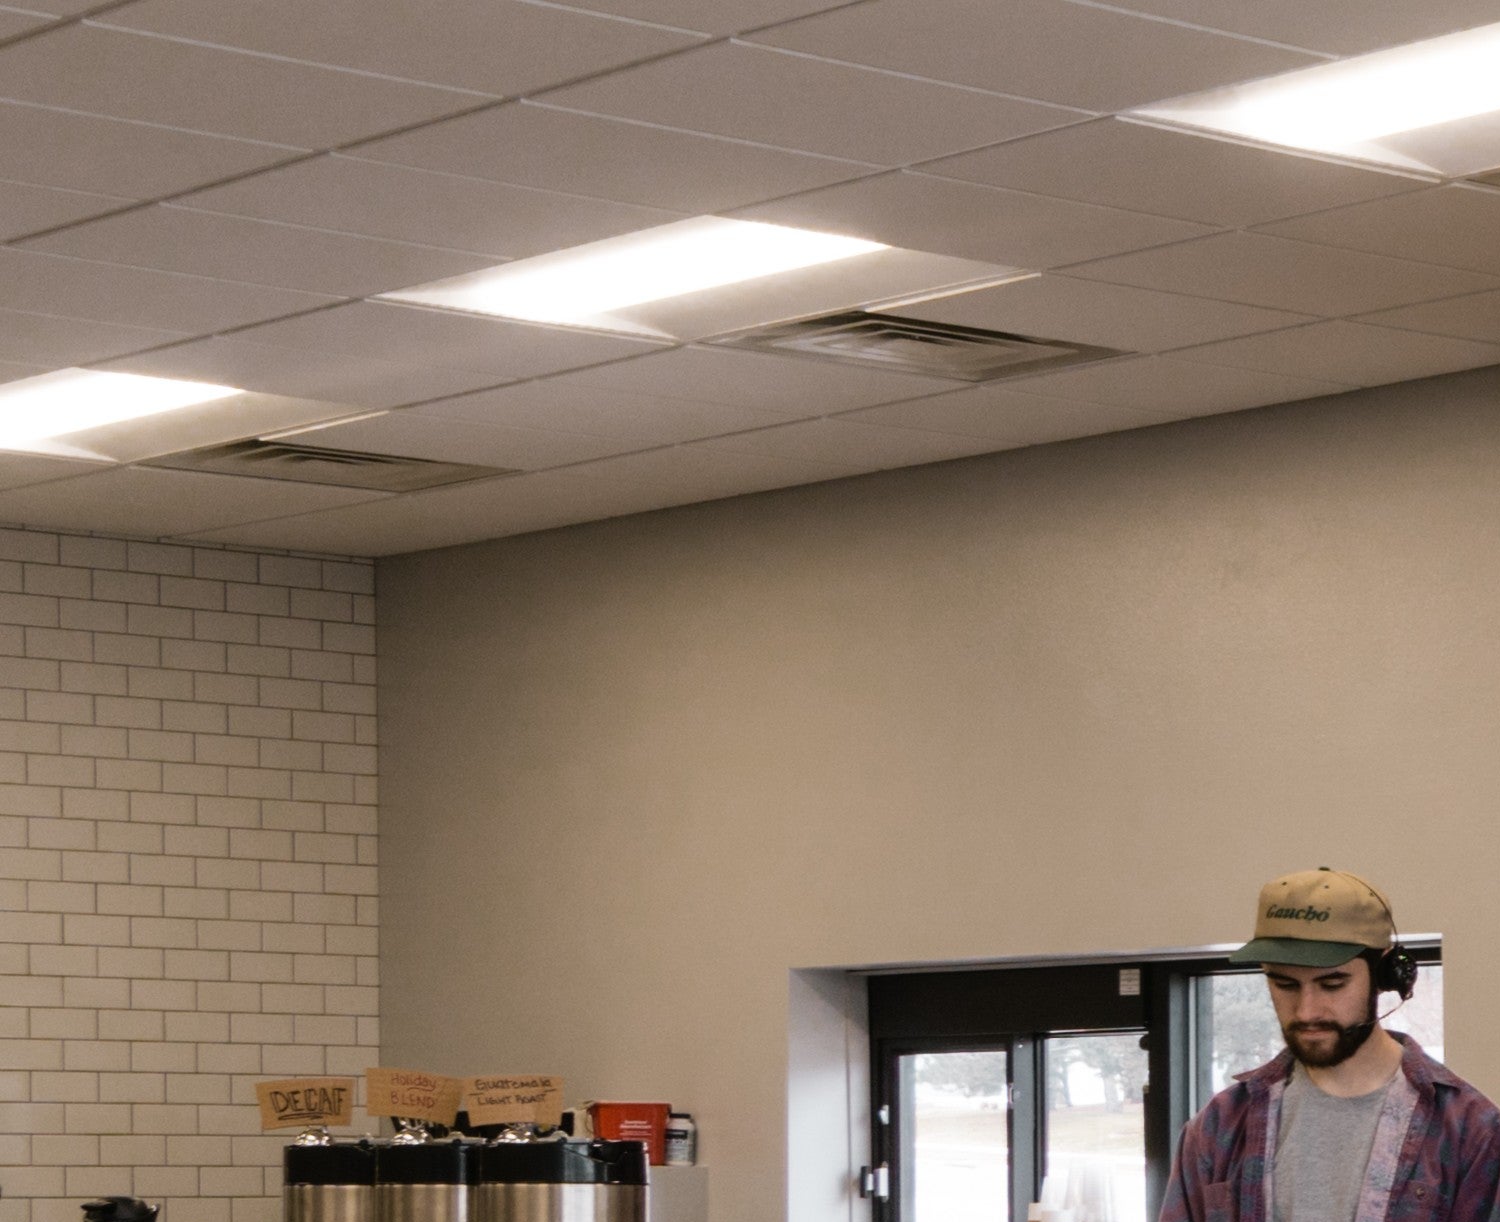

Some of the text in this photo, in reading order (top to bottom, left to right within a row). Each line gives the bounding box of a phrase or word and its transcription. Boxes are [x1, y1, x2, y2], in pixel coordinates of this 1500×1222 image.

[392, 1076, 437, 1091] Holiday
[270, 1087, 347, 1114] DECAF
[391, 1091, 436, 1108] BLEND
